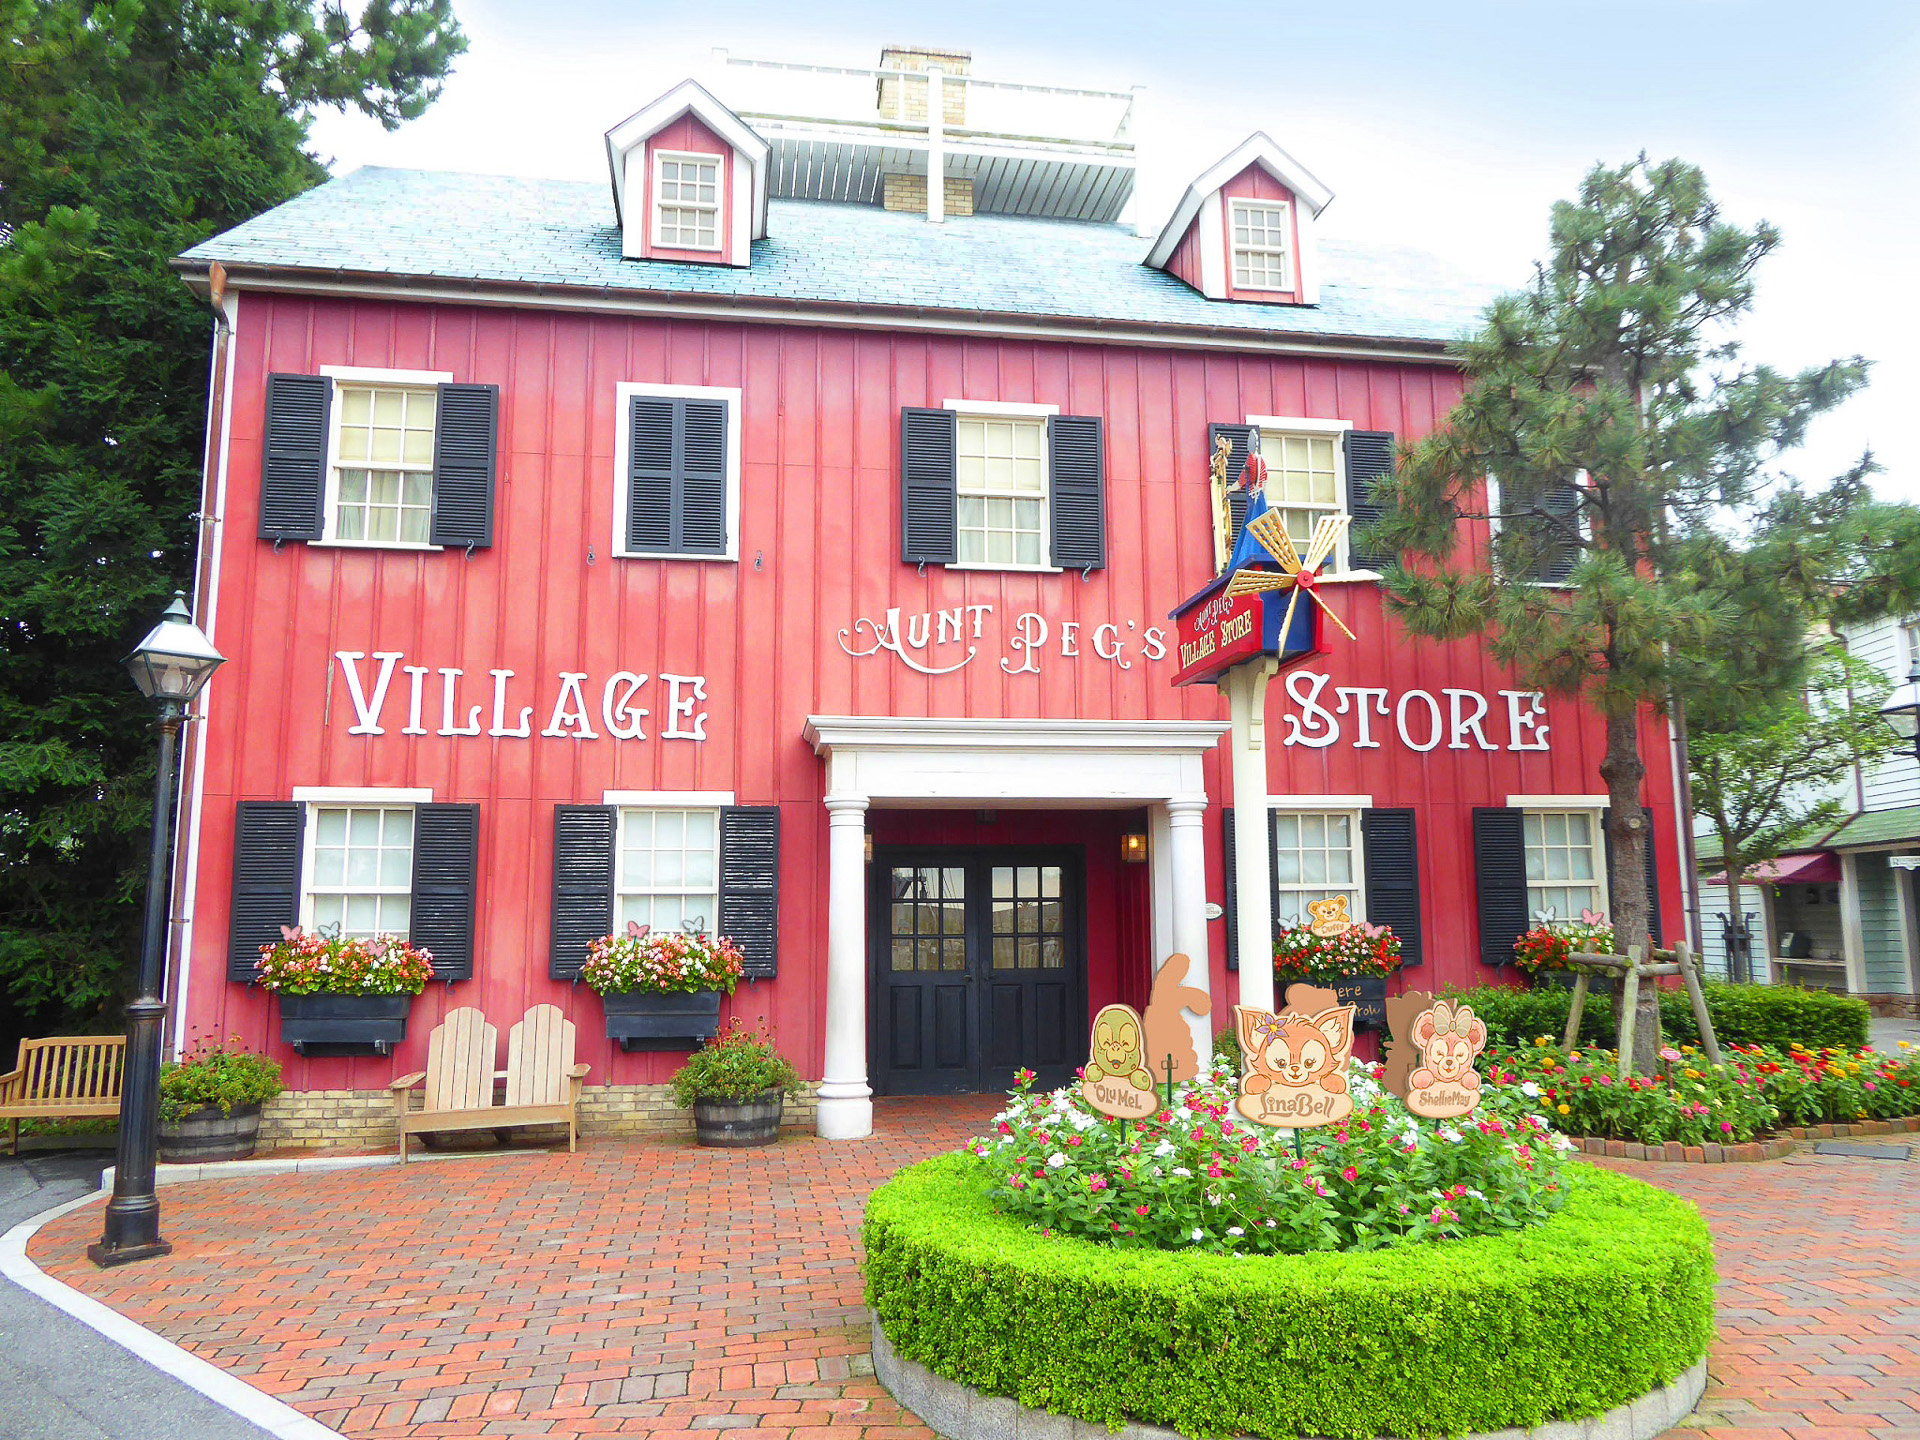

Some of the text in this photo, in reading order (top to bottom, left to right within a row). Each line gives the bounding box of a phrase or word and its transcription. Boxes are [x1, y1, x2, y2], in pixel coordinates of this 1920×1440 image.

[837, 604, 1168, 675] AUNT PEG'S
[1180, 609, 1252, 669] VILLAGE STORE
[335, 650, 1550, 751] VILLAGE STORE
[1321, 923, 1345, 934] Duffy
[1258, 1092, 1335, 1120] LinaBell
[1418, 1090, 1471, 1107] ShellieMay
